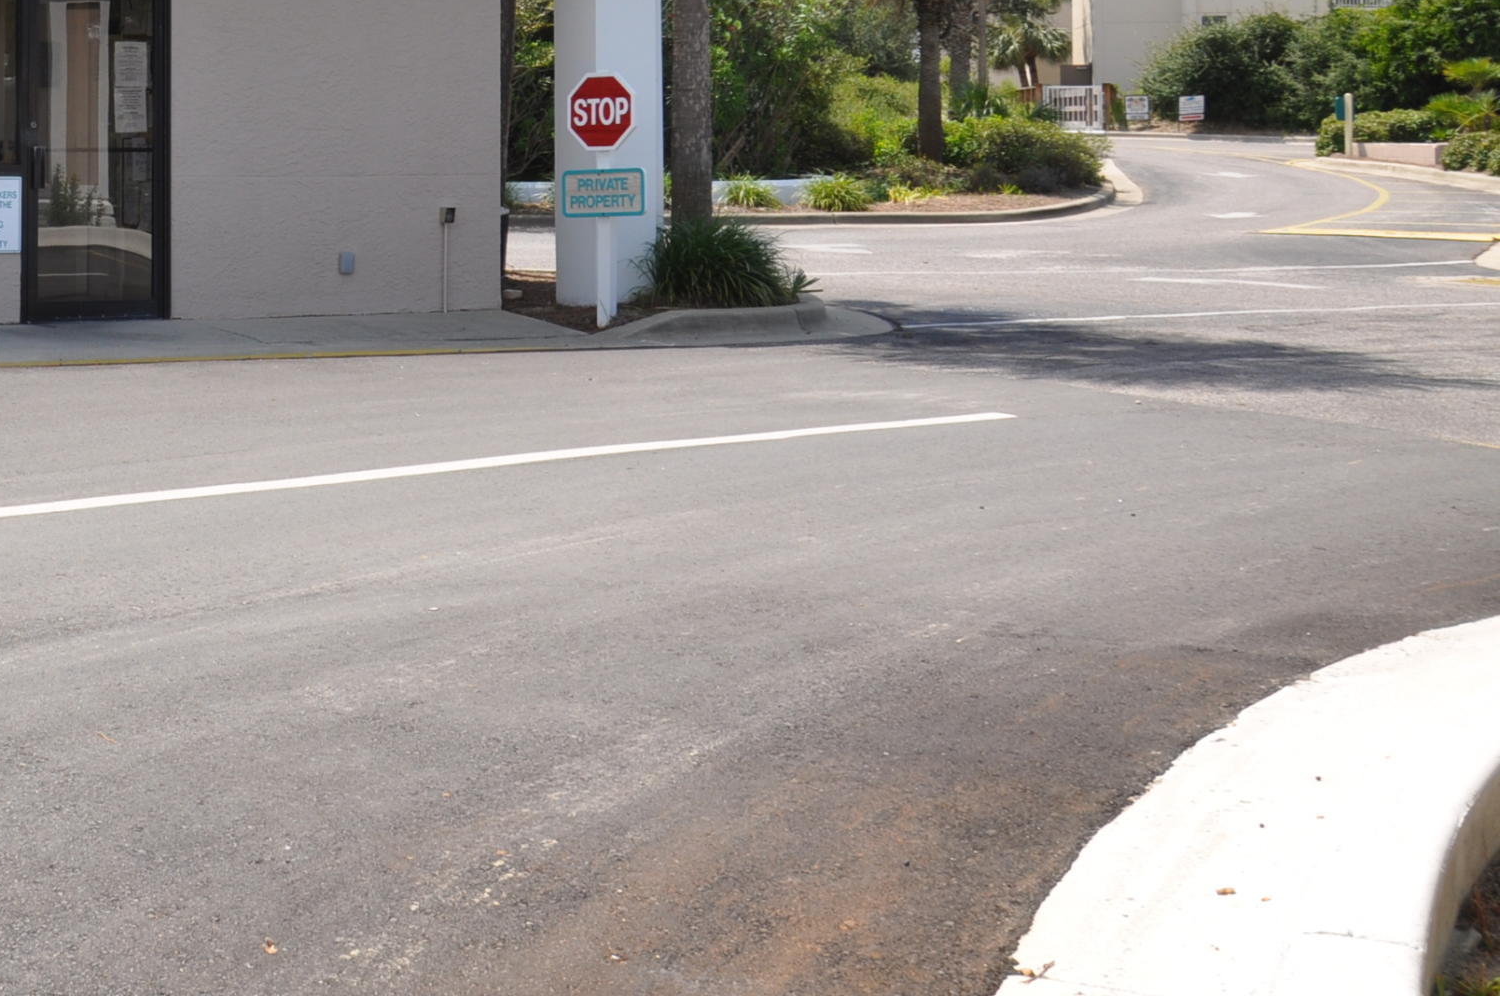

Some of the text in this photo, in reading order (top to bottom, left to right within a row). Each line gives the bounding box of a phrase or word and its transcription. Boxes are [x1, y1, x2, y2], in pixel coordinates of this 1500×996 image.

[573, 96, 629, 127] STOP
[577, 178, 629, 192] PRIVATE
[570, 194, 636, 209] PROPERTY
